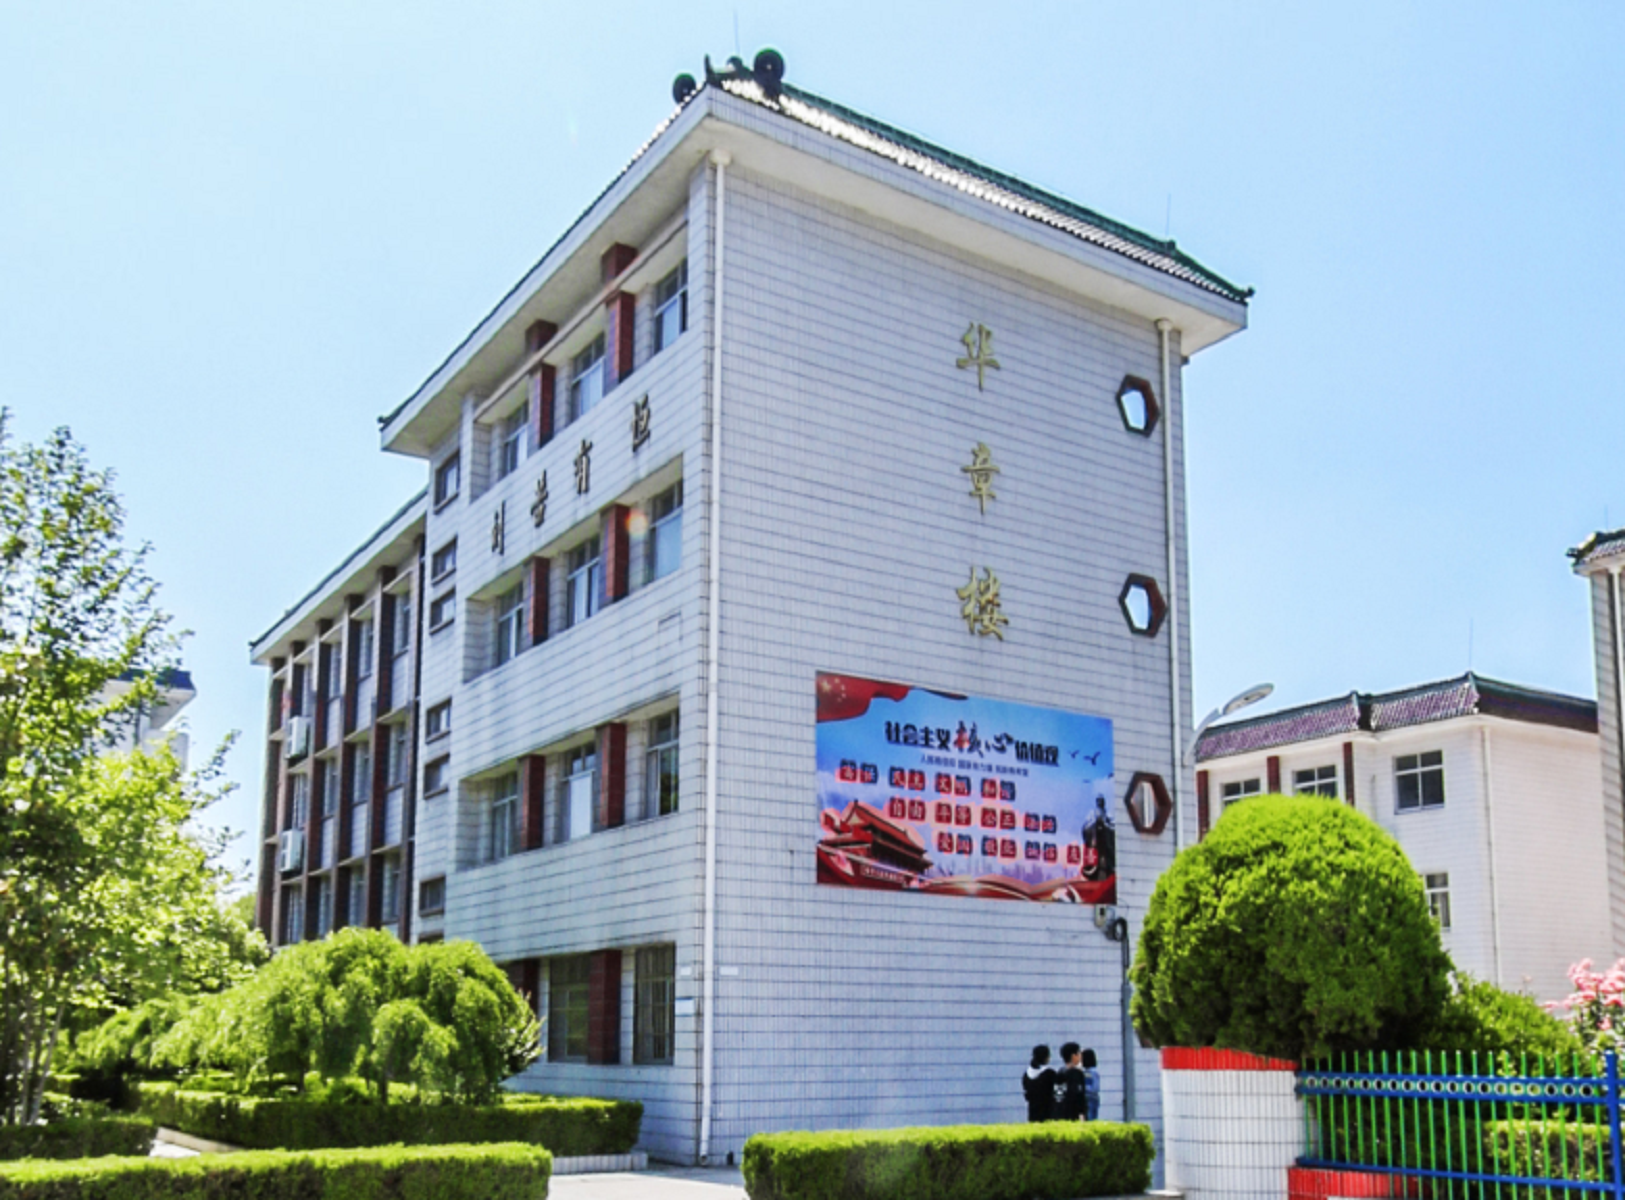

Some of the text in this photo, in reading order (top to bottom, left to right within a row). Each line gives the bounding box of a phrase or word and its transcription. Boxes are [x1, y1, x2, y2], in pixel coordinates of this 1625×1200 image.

[956, 322, 1009, 642] 华章楼
[885, 720, 1059, 767] 社会主义核心价值观
[890, 797, 925, 821] 自由
